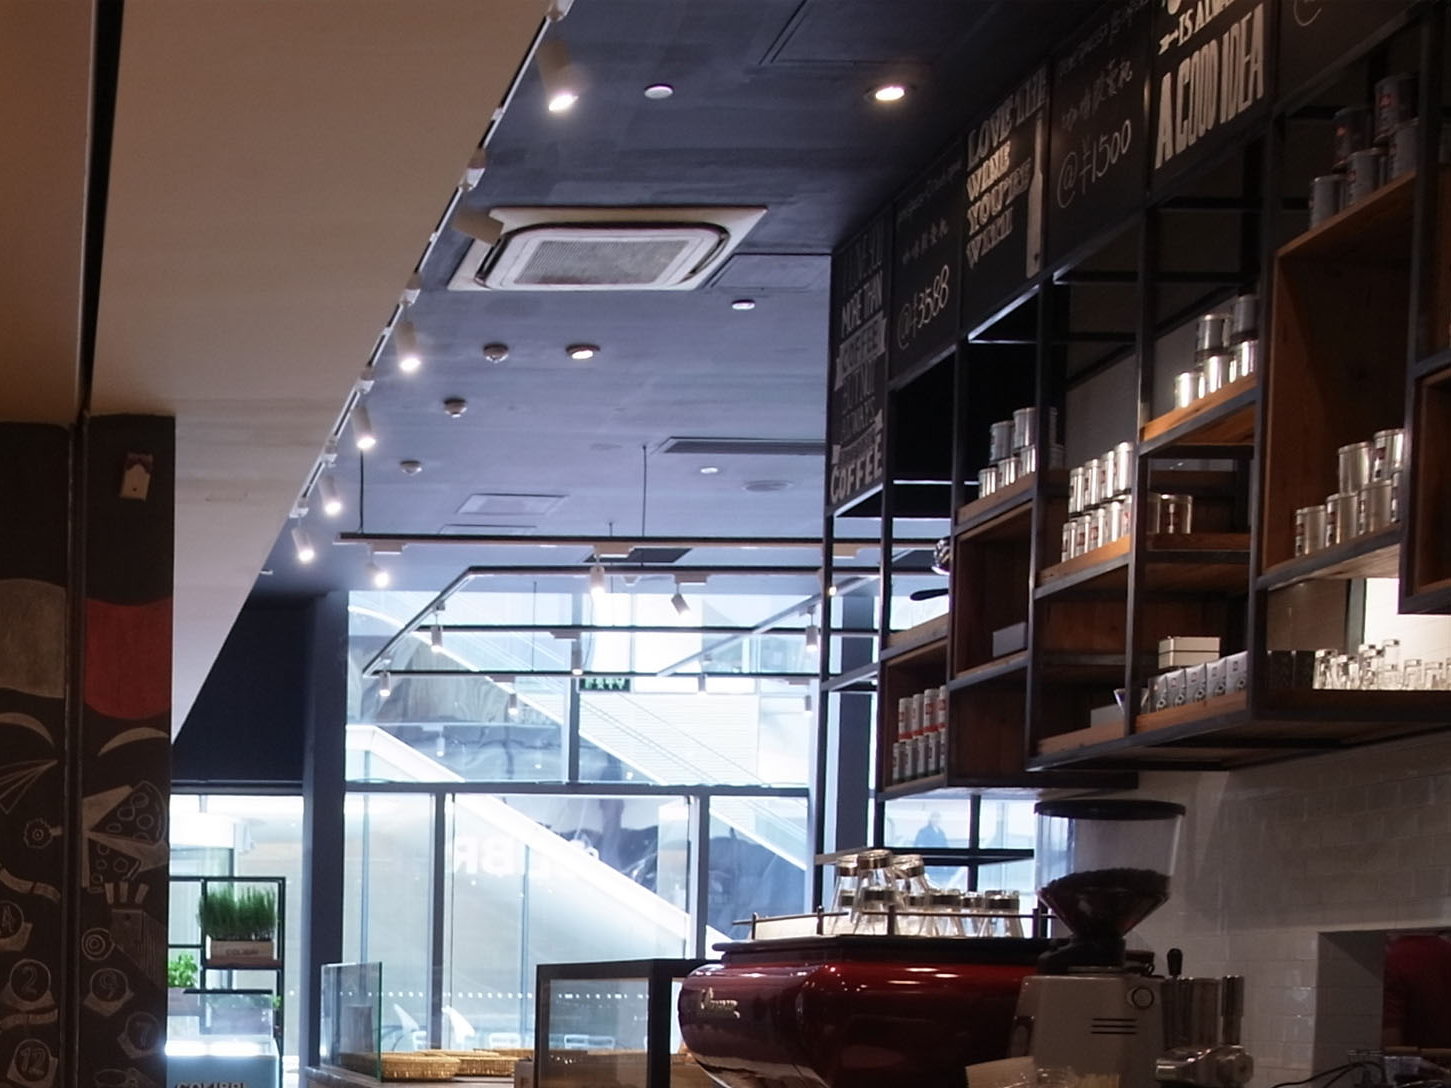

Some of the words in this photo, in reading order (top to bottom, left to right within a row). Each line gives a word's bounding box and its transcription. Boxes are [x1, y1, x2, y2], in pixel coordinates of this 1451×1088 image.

[1154, 71, 1174, 170] A
[1219, 2, 1265, 125] IDEA
[966, 93, 1014, 173] LOVE
[965, 139, 1012, 203] WINE
[829, 432, 883, 504] COFFEE
[22, 964, 39, 995] 2
[19, 1046, 47, 1076] 12
